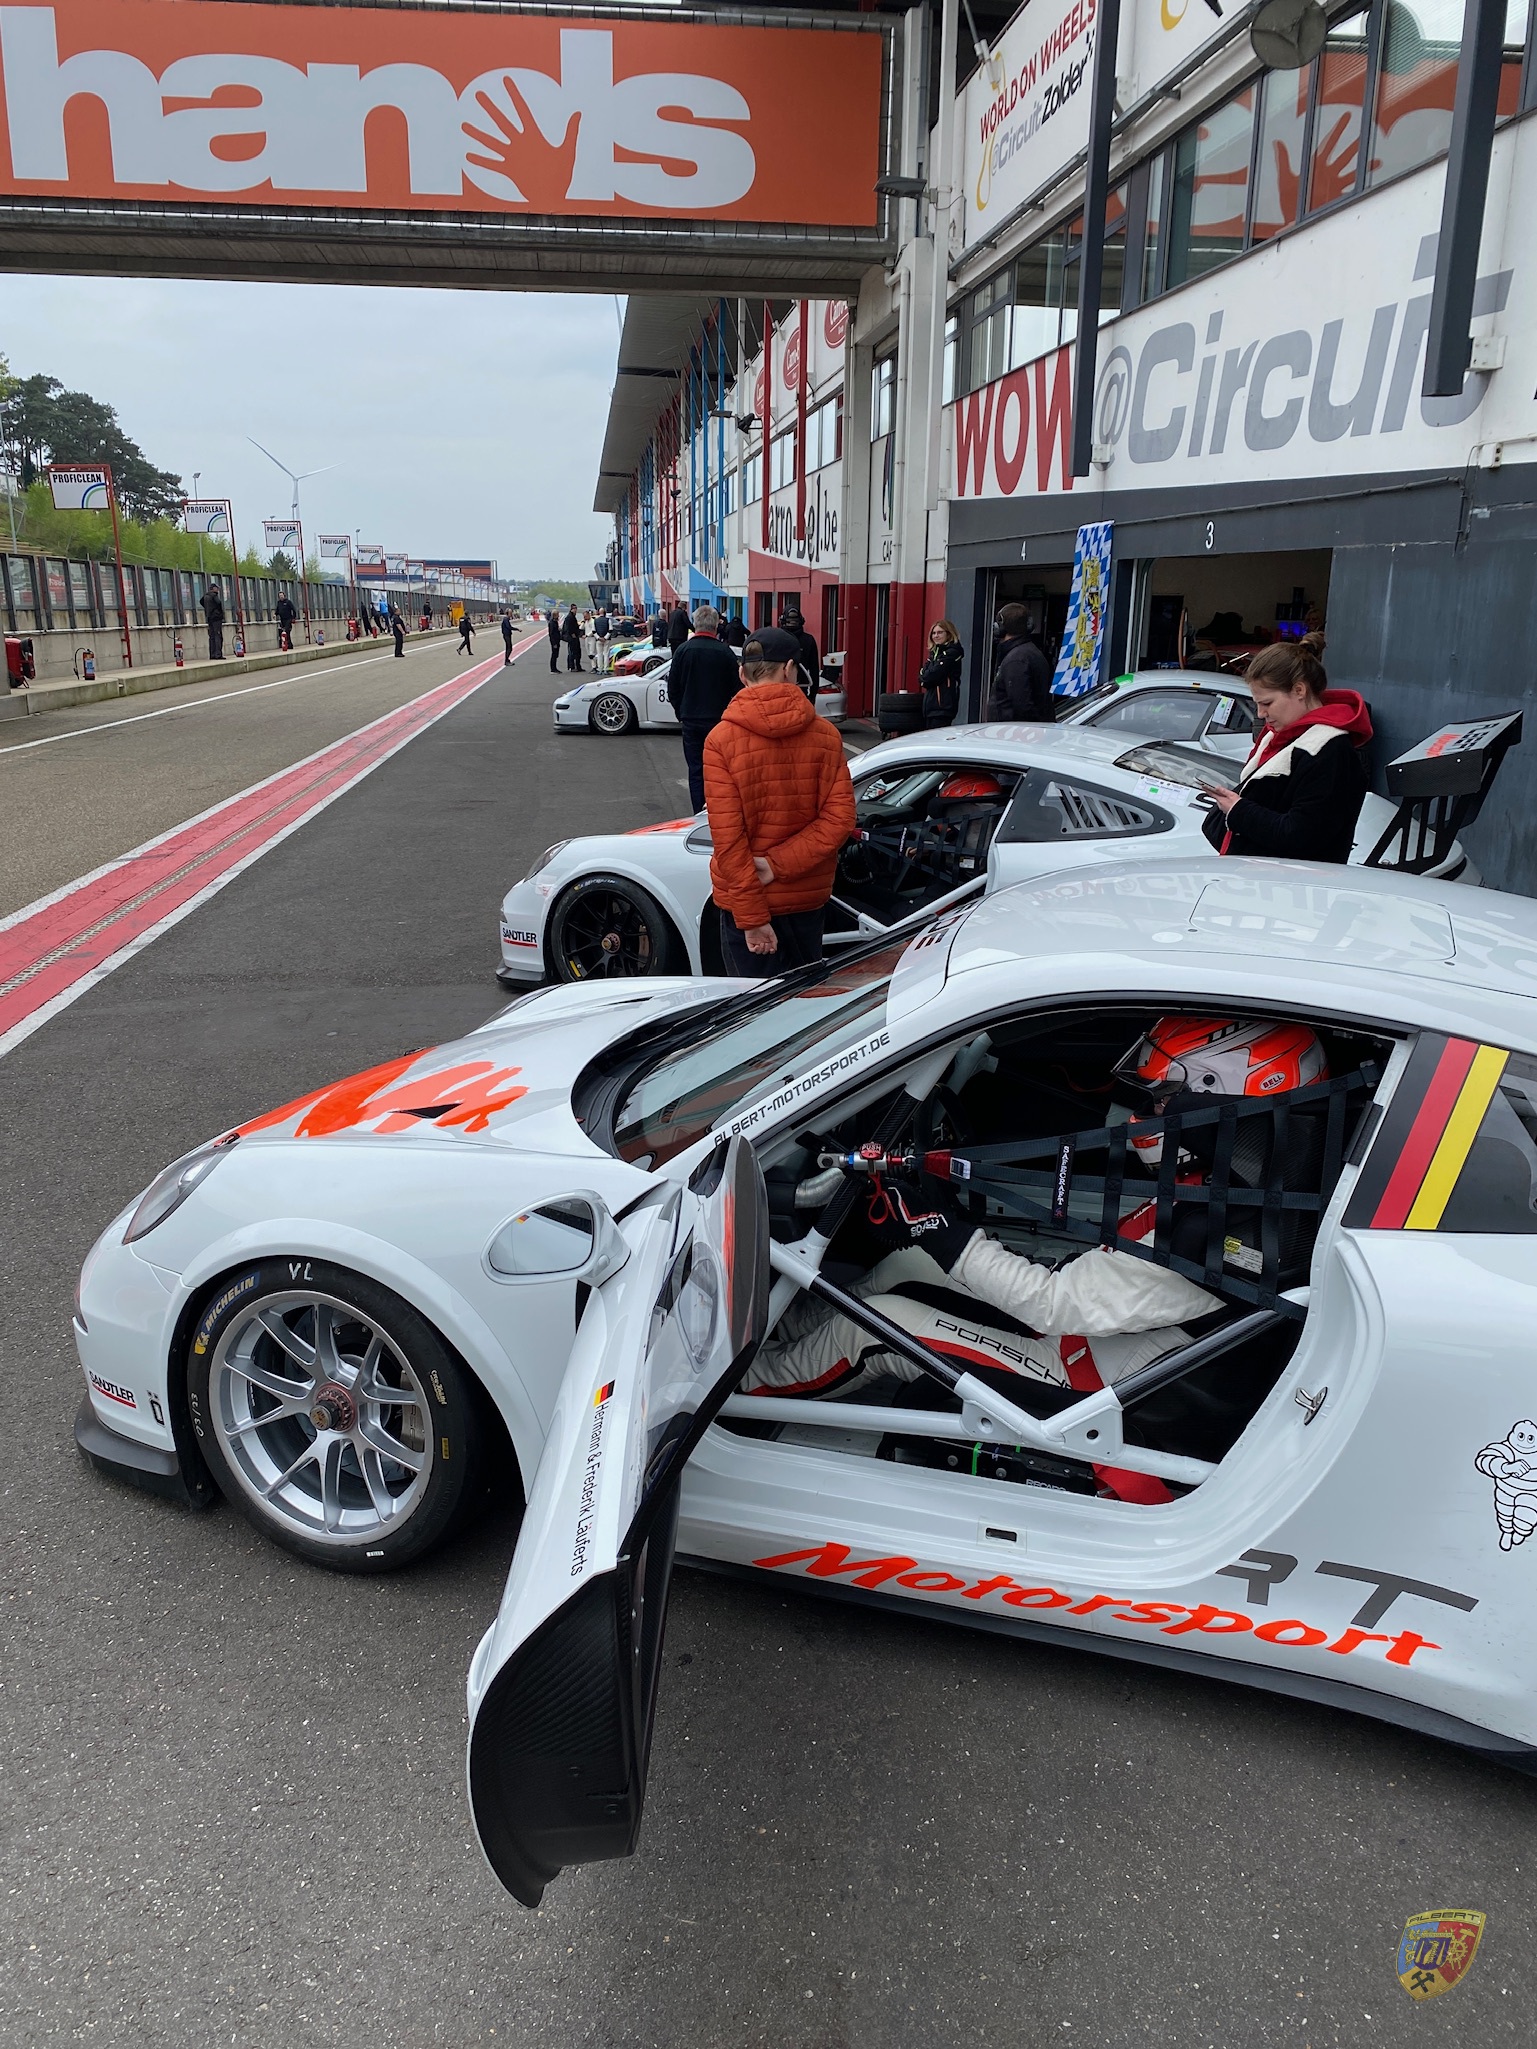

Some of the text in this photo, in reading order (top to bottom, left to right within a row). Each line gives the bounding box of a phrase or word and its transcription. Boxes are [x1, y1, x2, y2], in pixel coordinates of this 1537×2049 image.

[980, 0, 1096, 144] WORLD ON WHEELS
[1, 6, 756, 208] hands
[52, 473, 102, 483] PROFICLEAN
[186, 505, 223, 513] PROFICLEAN
[763, 474, 838, 563] arro-el.be
[1205, 520, 1215, 549] 3
[1020, 541, 1027, 561] 4
[714, 1032, 891, 1148] ALBERT-MOTORSPORT.DE
[1263, 1075, 1285, 1089] BELL
[861, 1143, 882, 1151] PUSH
[1056, 1145, 1070, 1206] SAFECRAFT
[205, 1276, 255, 1331] MICHELIN
[935, 1318, 1073, 1390] PORSCH
[89, 1370, 136, 1403] SANDTLER
[570, 1401, 609, 1578] Hermann & Frederik Läuferts
[752, 1542, 1443, 1666] Motorsport
